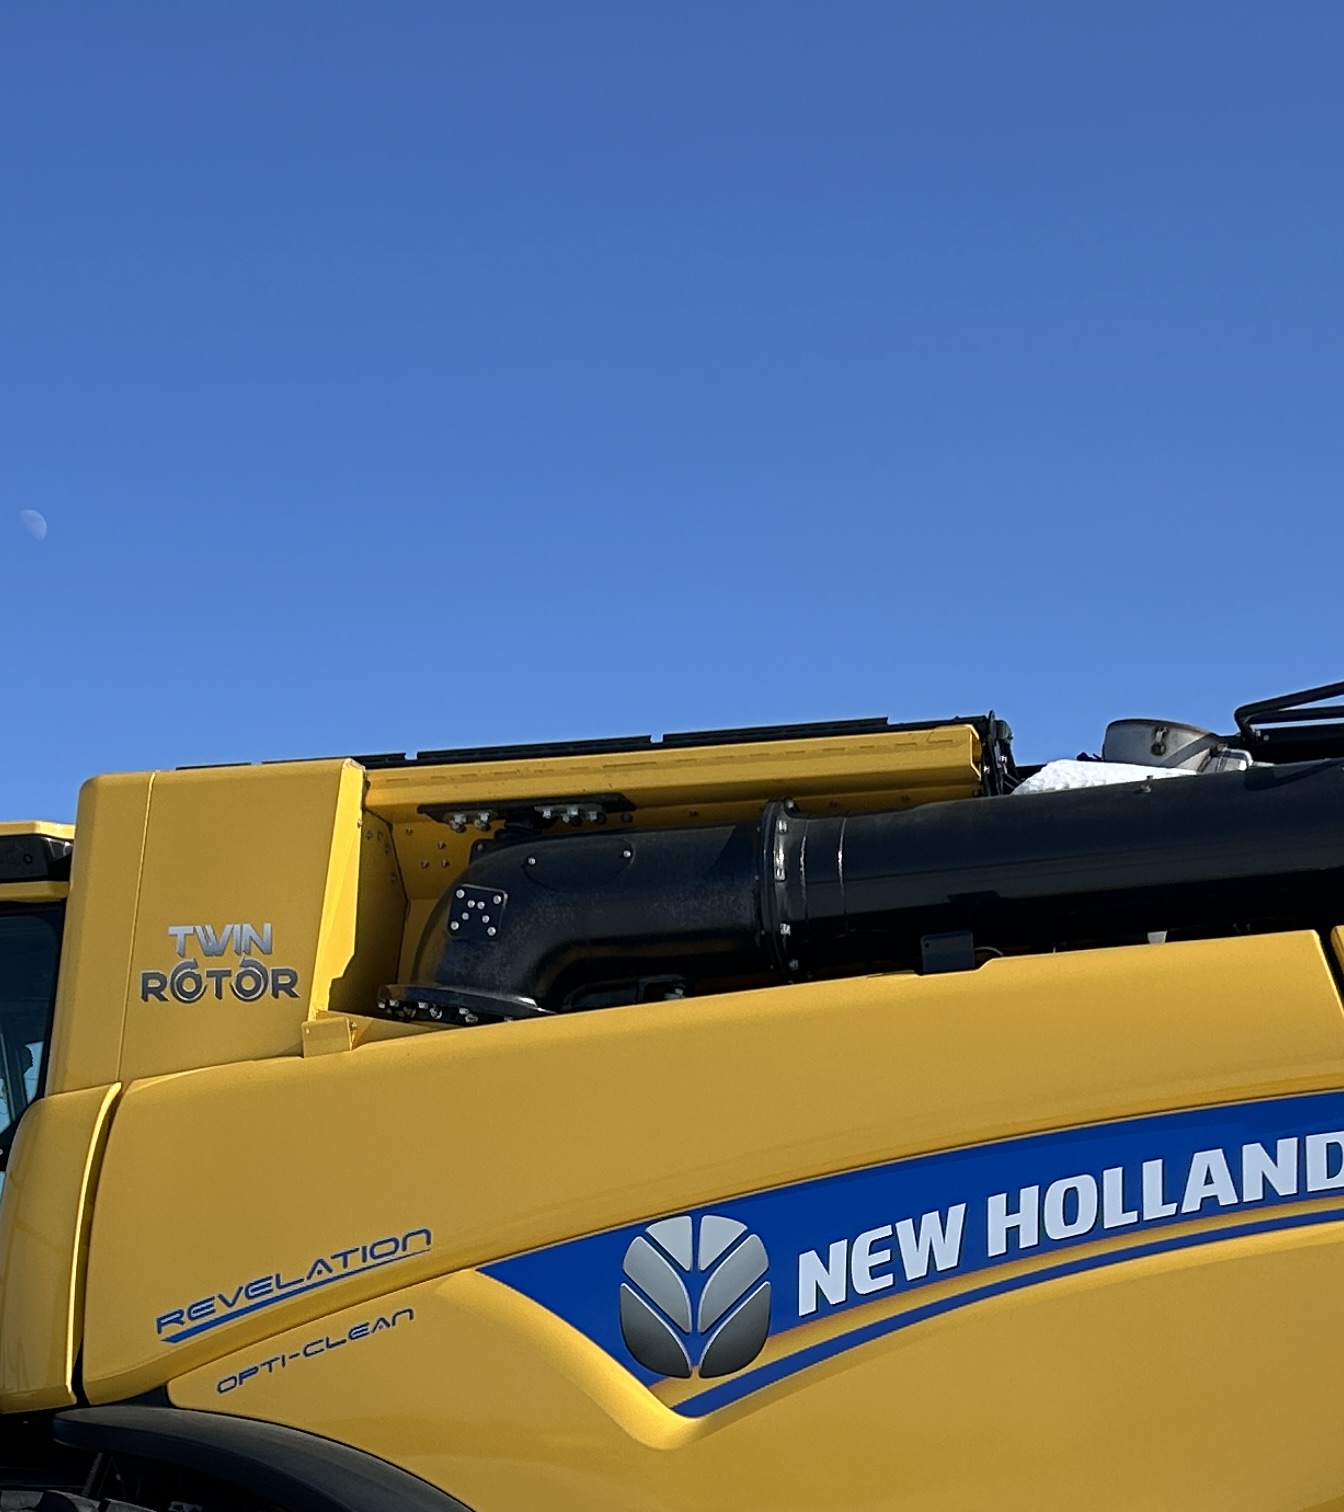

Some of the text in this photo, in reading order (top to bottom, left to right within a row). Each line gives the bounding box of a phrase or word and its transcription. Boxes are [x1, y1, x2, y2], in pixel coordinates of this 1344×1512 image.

[140, 957, 300, 1002] ROTOR
[168, 923, 273, 956] TWIN
[156, 1227, 433, 1335] REVELATION
[797, 1203, 966, 1317] NEW
[216, 1308, 414, 1395] OPTI-CLEAN
